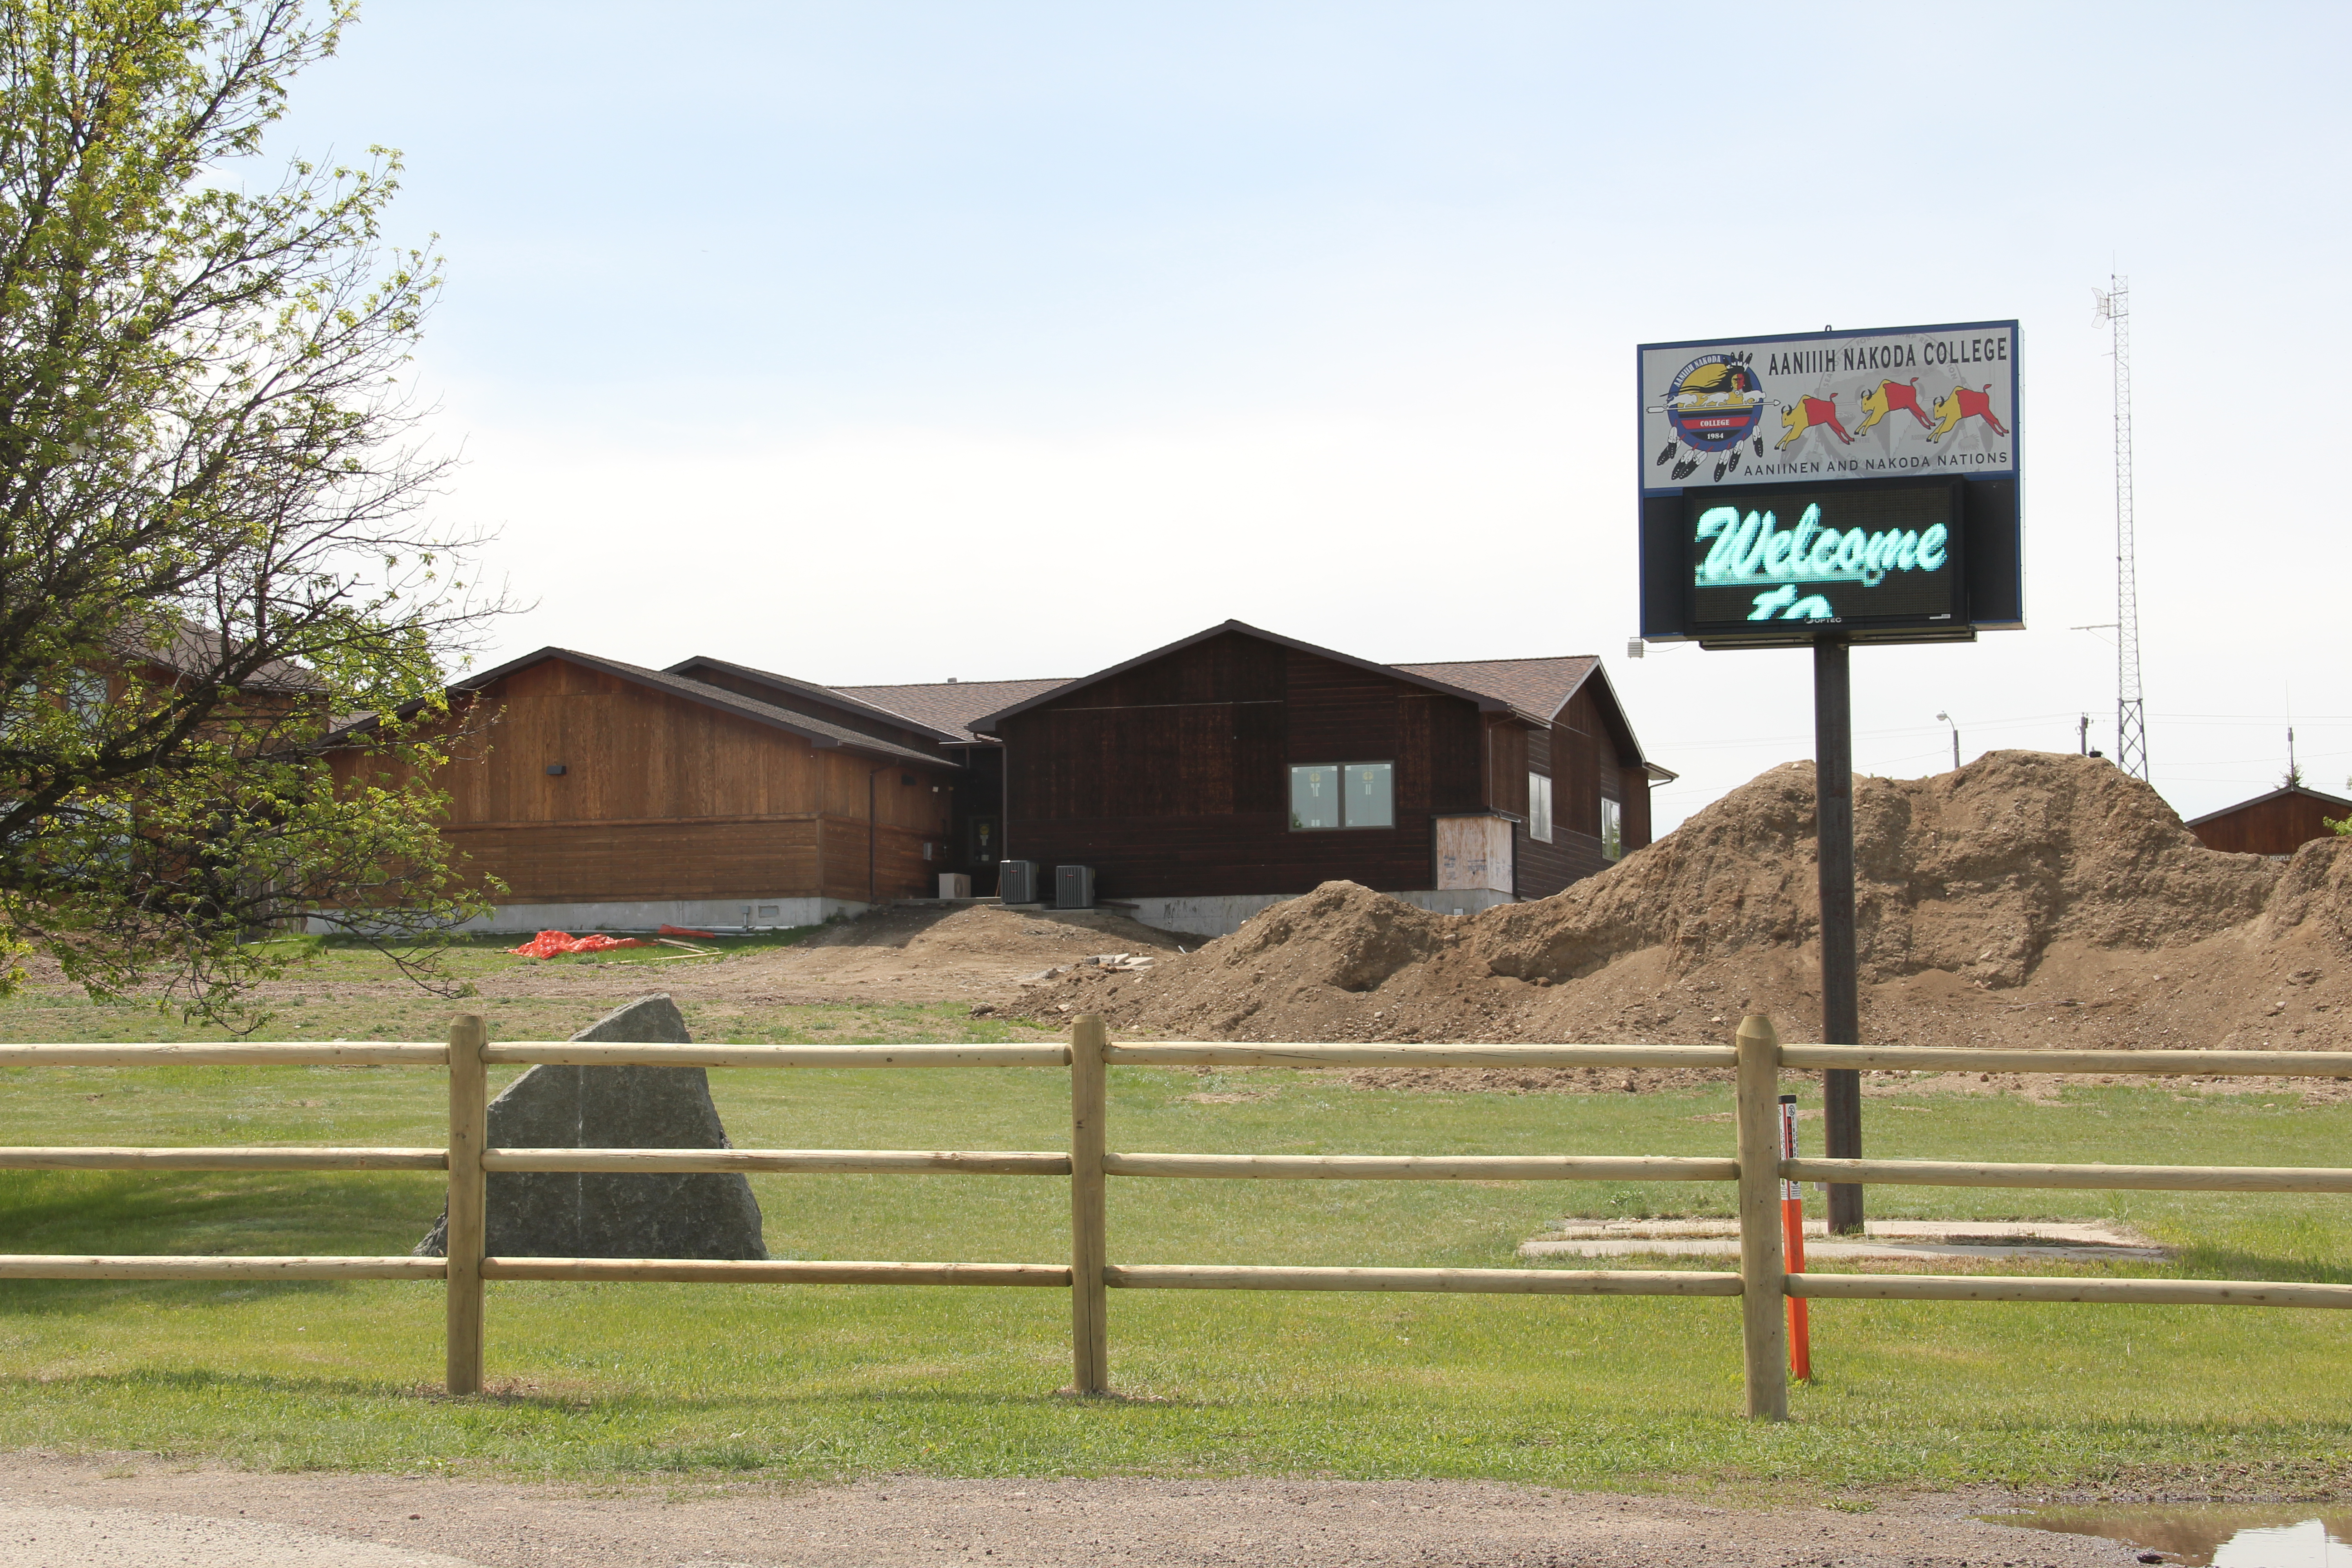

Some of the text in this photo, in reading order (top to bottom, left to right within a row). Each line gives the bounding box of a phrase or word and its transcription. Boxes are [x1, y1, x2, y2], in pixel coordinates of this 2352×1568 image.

[1694, 355, 1721, 368] NAKODA
[1768, 349, 1835, 376] AANIIIH
[1844, 344, 1916, 371] NAKODA
[1924, 336, 2007, 365] COLLEGE
[1744, 461, 1819, 476] AANIINEN
[1827, 460, 1858, 472] AND
[1866, 456, 1930, 470] NAKODA
[1937, 452, 2007, 466] NATIONS
[1695, 502, 1948, 584] Welcome
